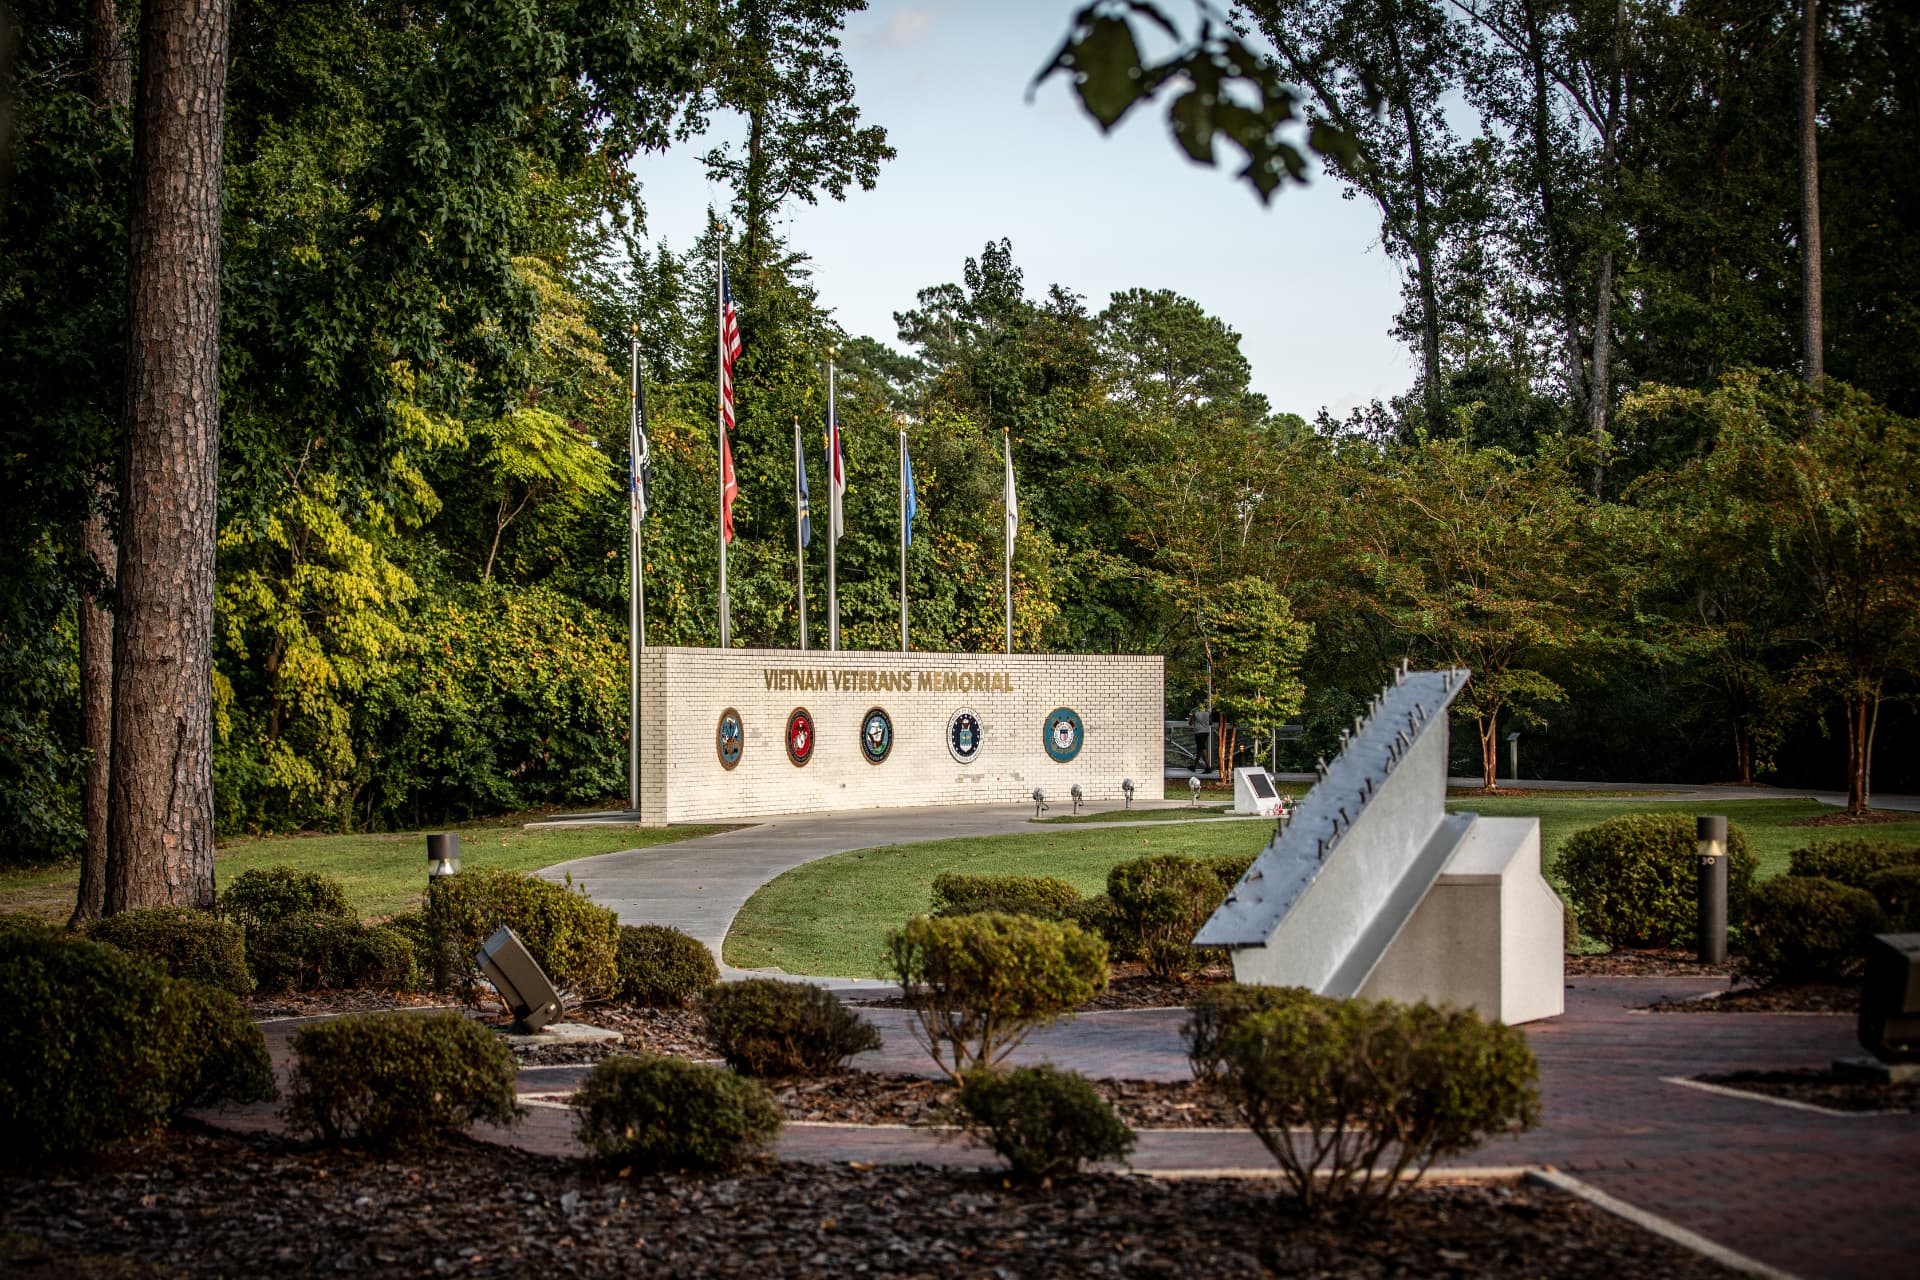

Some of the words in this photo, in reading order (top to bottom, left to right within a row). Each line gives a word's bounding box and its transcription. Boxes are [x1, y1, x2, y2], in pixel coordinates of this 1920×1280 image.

[764, 669, 828, 691] VIETNAM
[832, 670, 912, 691] VETERANS
[917, 671, 1014, 692] MEMORIAL
